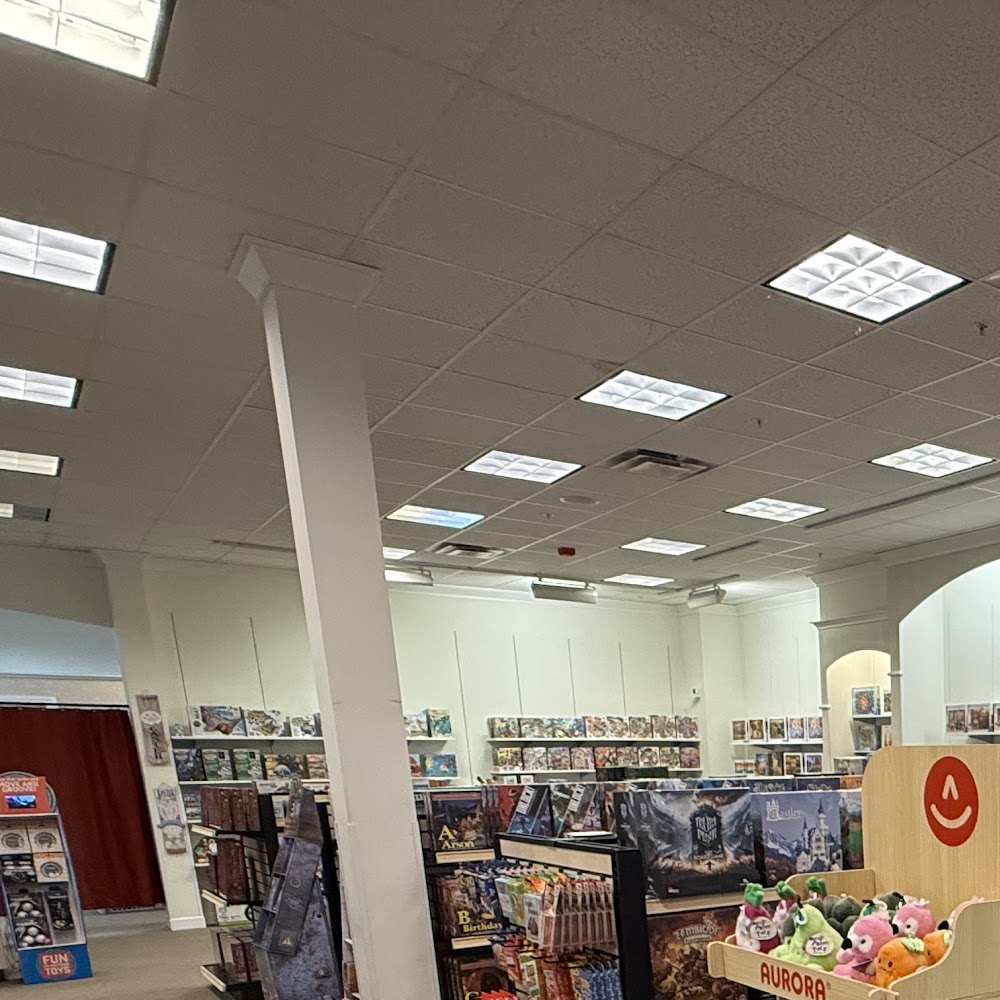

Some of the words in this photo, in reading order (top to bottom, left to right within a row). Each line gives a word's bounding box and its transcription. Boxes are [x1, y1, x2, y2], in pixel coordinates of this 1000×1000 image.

[438, 824, 456, 840] A
[441, 840, 475, 850] Arson
[457, 910, 471, 925] B
[42, 953, 69, 965] FUN
[45, 966, 71, 976] TOYS
